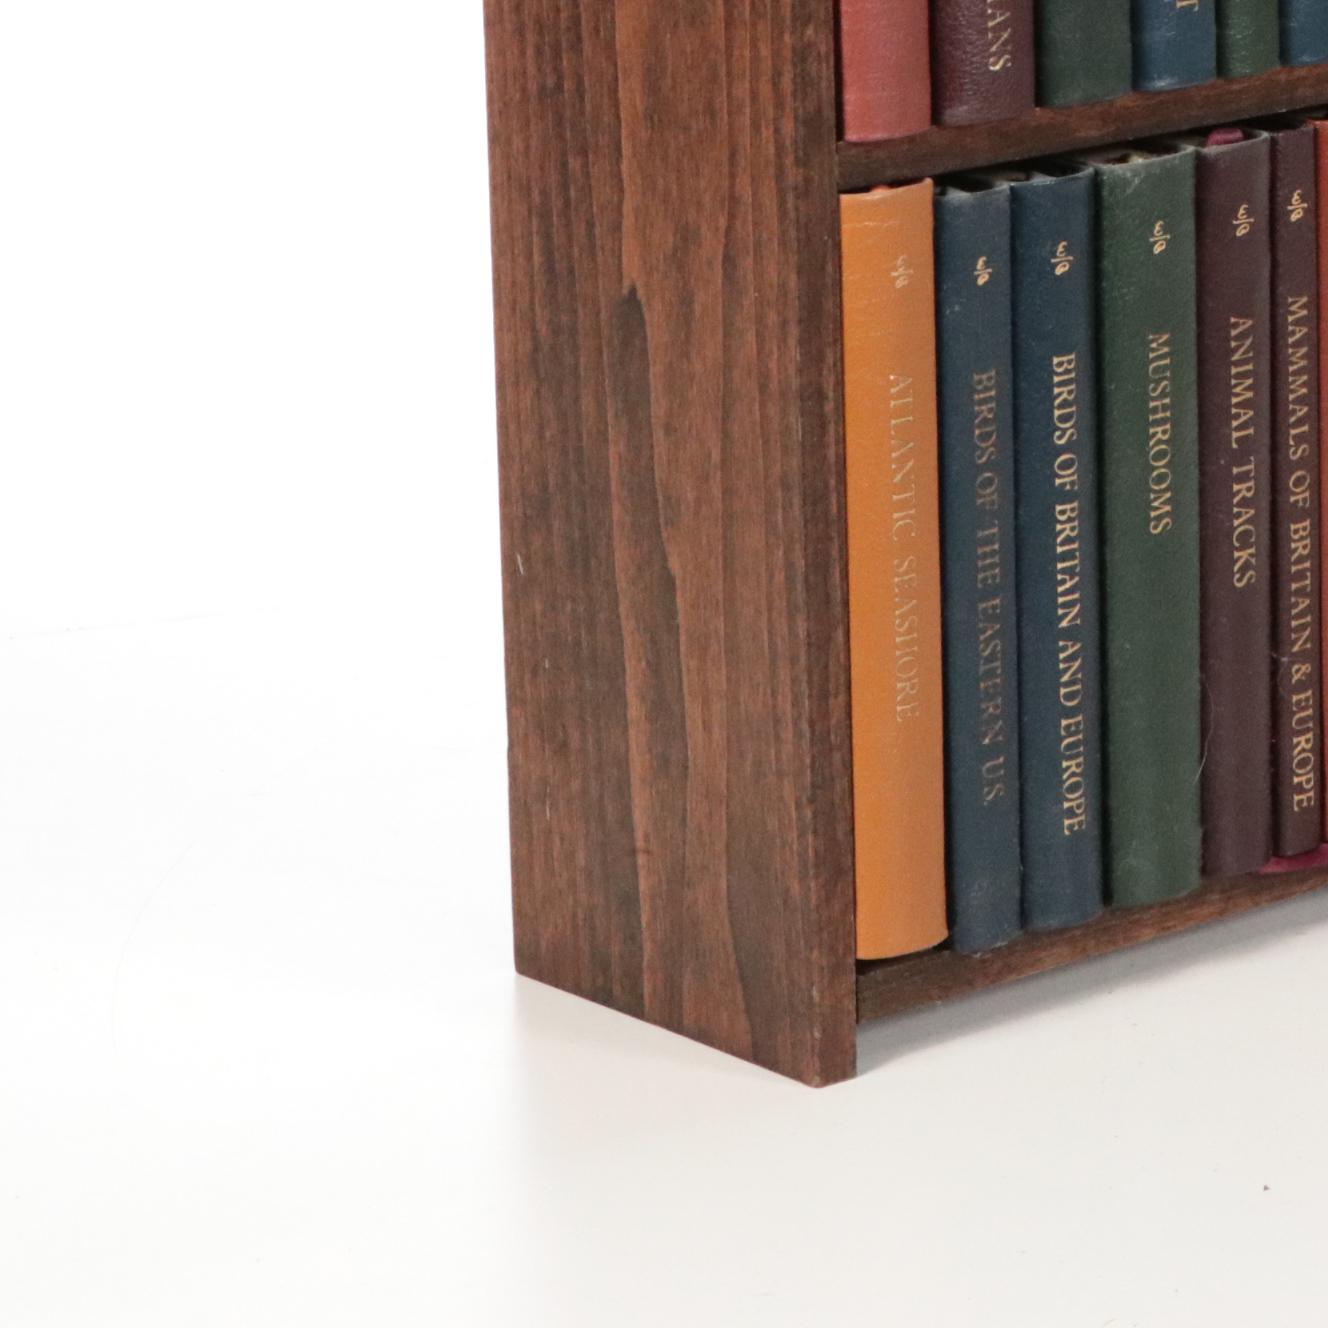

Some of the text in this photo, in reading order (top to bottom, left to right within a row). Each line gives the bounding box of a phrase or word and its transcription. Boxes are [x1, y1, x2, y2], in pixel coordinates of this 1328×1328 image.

[971, 370, 996, 463] BIRDS
[975, 470, 998, 510] OF
[1148, 333, 1172, 535] MUSHROOMS
[1229, 316, 1255, 588] ANIMAL TRACKS
[887, 373, 921, 723] ATLANTIC SEASHORE
[976, 518, 1000, 589] THE
[1052, 352, 1086, 835] BIRDS OF BRITAIN AND EUROPE
[1287, 296, 1314, 811] MAMMALS OF BRITAIN & EUROPE
[977, 597, 1002, 745] EASTERN
